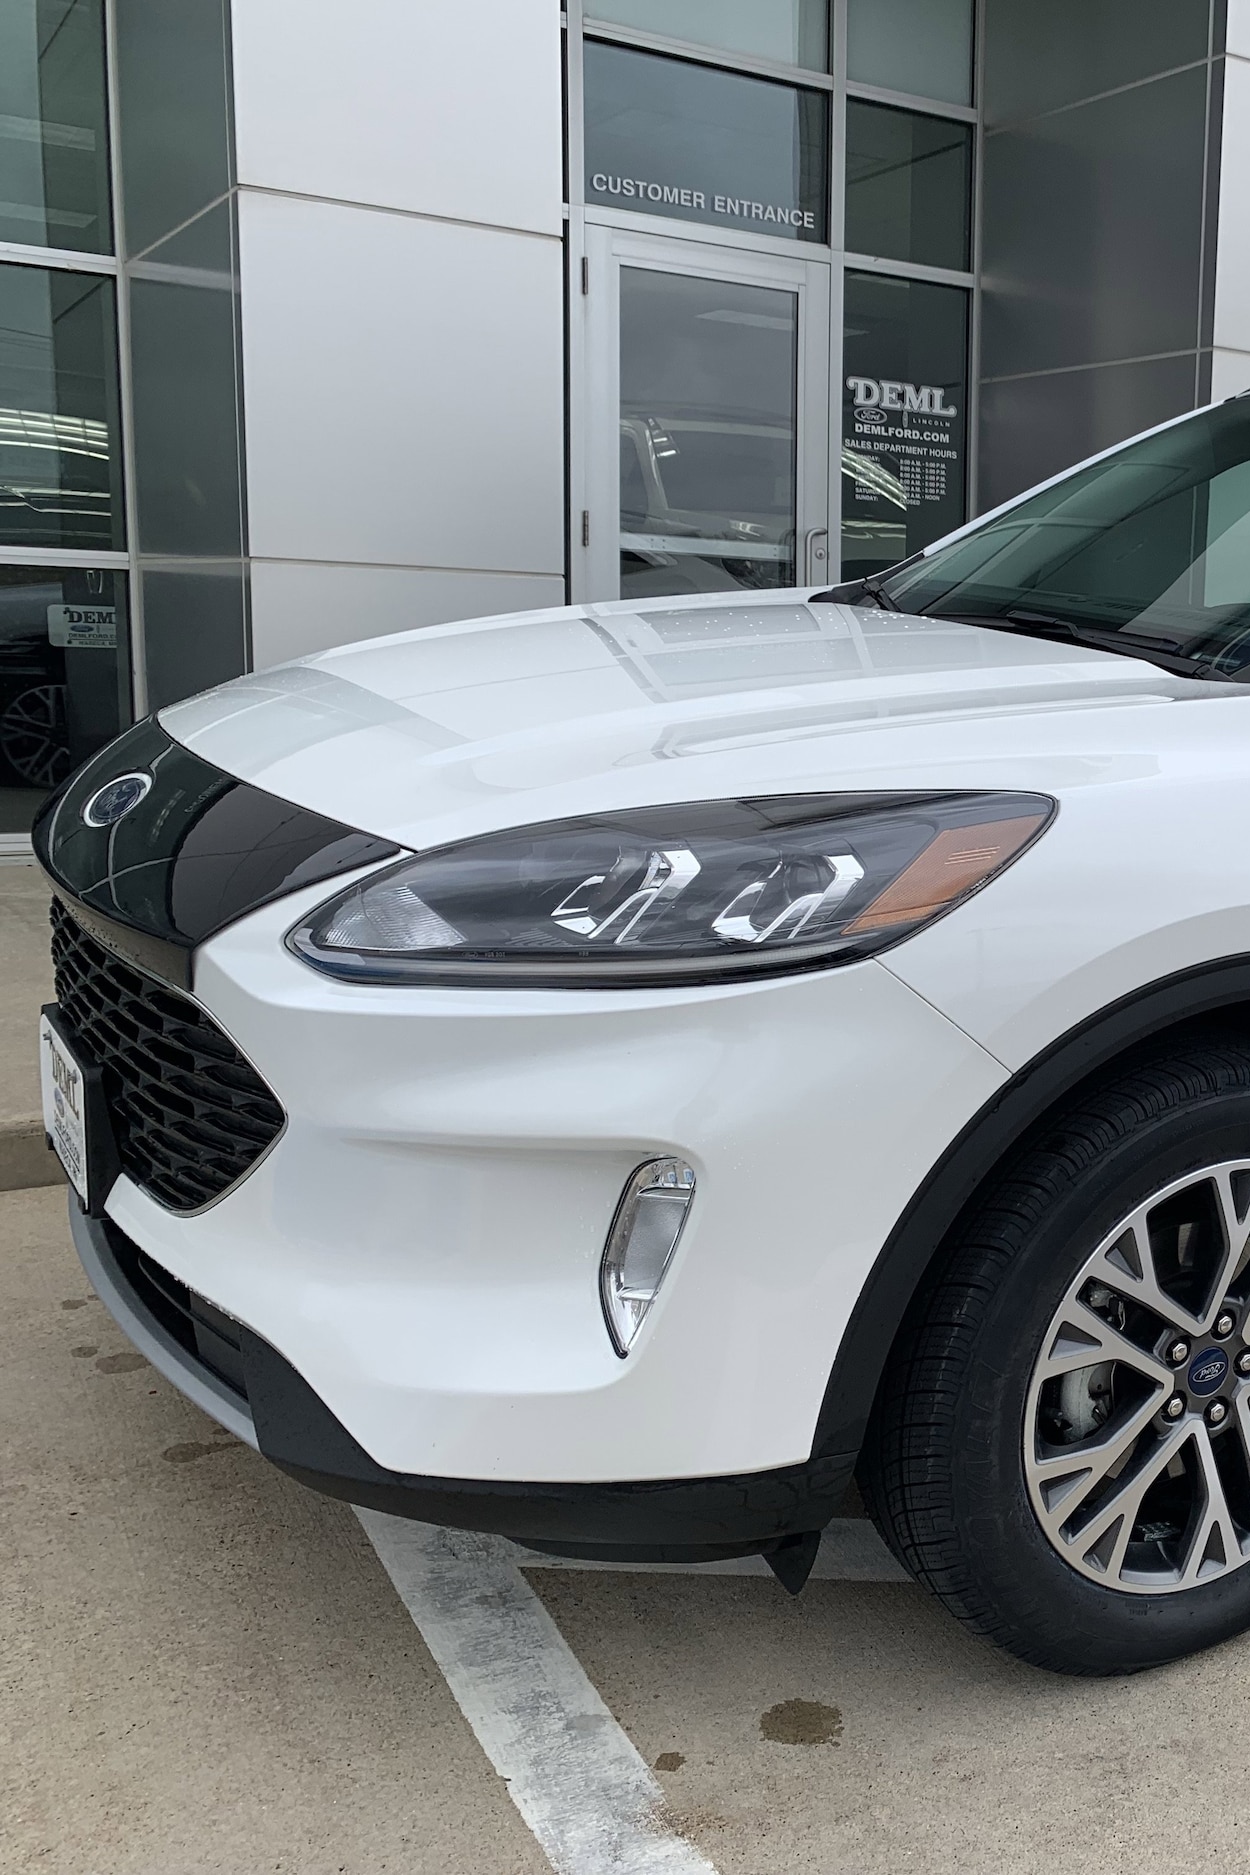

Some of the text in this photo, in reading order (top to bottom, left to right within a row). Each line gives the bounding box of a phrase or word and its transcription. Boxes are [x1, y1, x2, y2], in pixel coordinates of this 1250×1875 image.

[592, 173, 815, 229] CUSTOMER ENTRANCE
[846, 376, 957, 418] DEML
[913, 417, 950, 427] LINCOLN
[855, 423, 950, 443] DEMLFORD.COM
[845, 438, 957, 459] SALES DEPARTMENT HOURS
